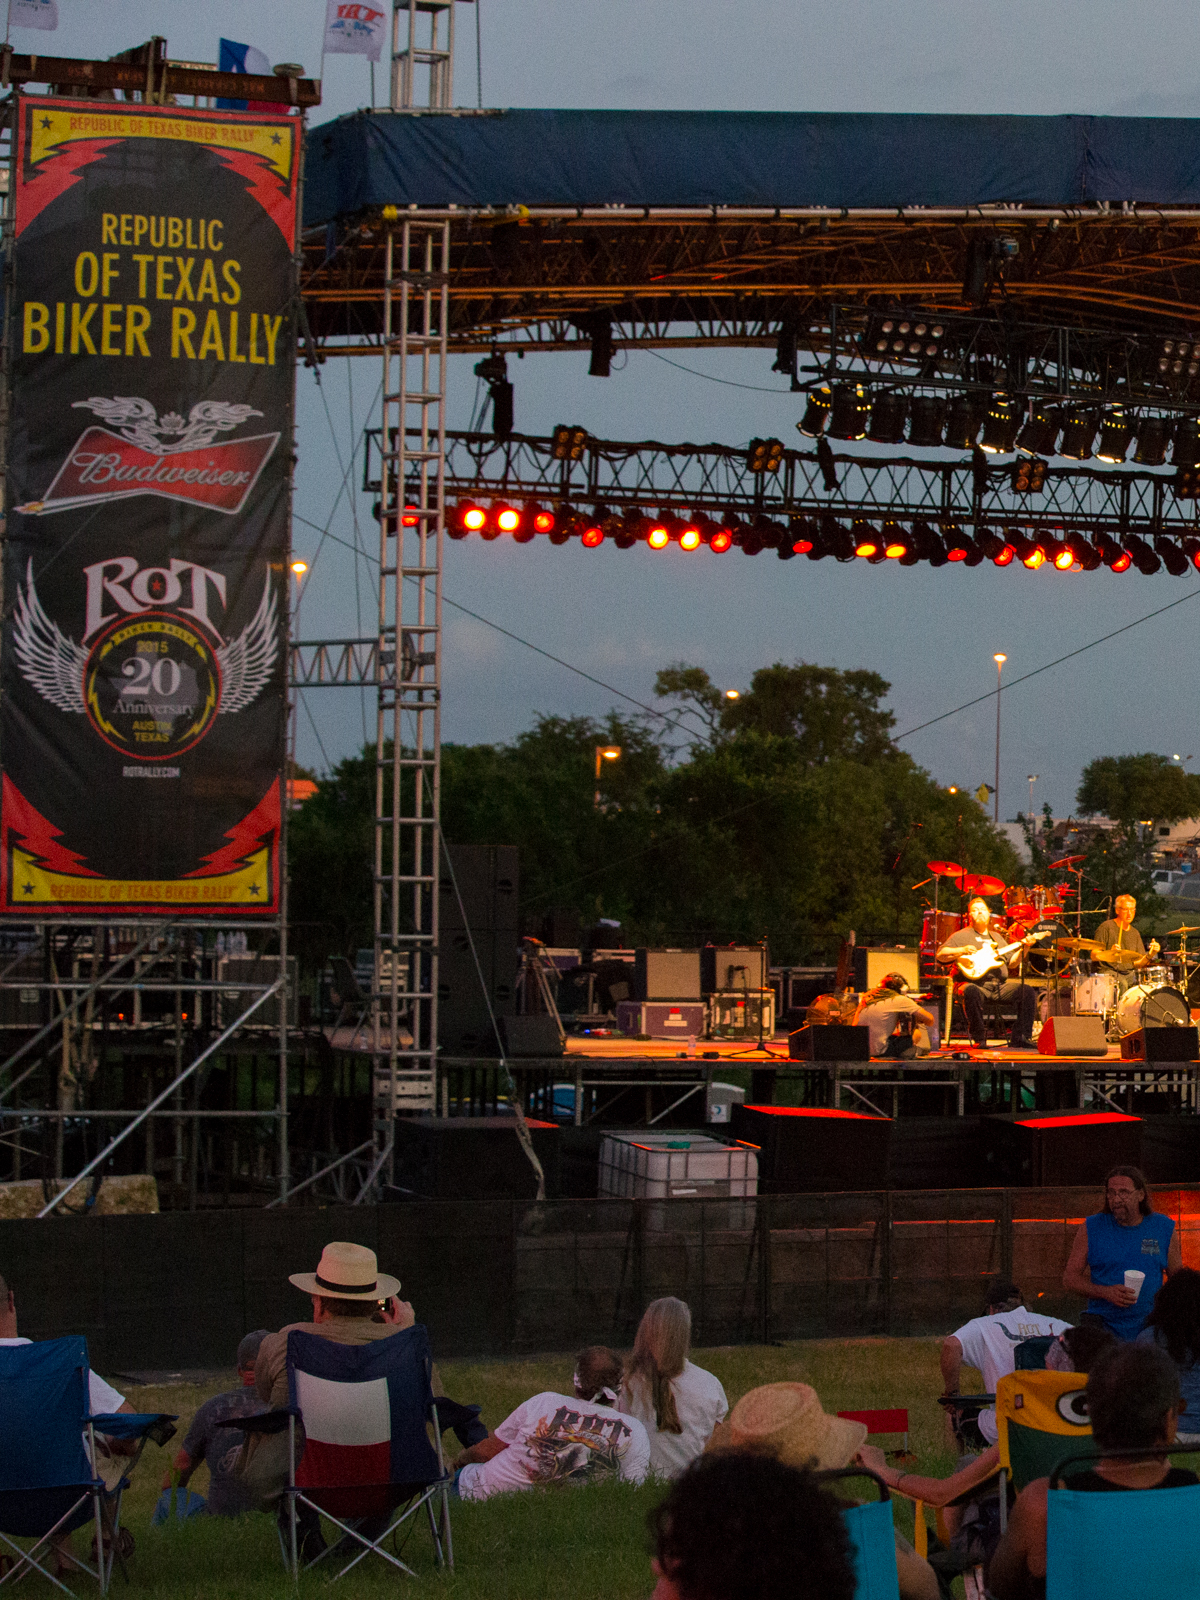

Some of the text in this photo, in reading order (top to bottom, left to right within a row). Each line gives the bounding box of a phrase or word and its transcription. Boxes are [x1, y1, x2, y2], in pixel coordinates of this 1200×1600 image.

[69, 116, 255, 142] REPUBLIC OF TEXAS BIKER RALLY
[102, 212, 224, 251] REPUBLIC
[74, 251, 242, 305] OF TEXAS
[22, 301, 283, 365] BIKER RALLY
[71, 452, 251, 488] Budweiser
[82, 556, 228, 648] ROT
[136, 640, 169, 653] 2015
[121, 657, 181, 696] 20
[112, 699, 195, 719] Anniversary
[132, 720, 173, 731] AUSTIN
[134, 732, 171, 742] TEXAS
[50, 883, 234, 900] REPUBLIC OF TEXAS BIKER RALLY
